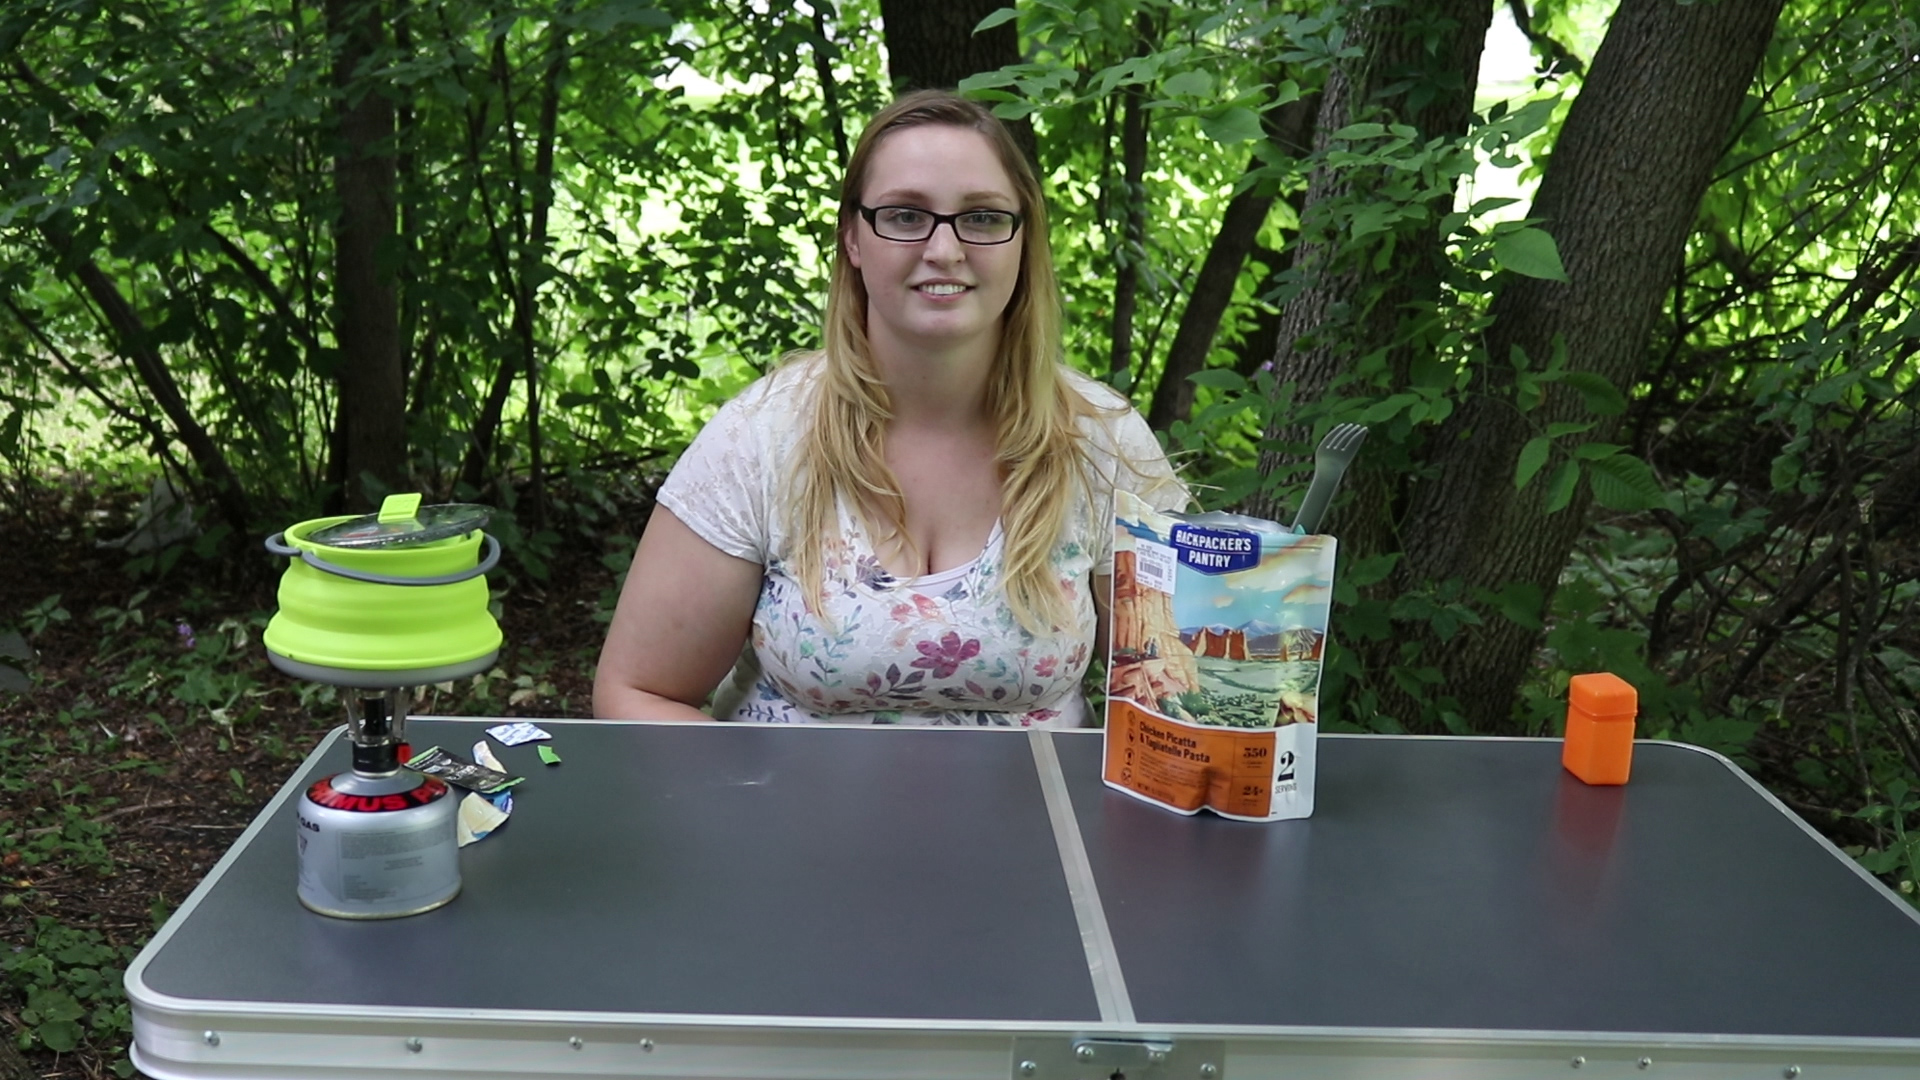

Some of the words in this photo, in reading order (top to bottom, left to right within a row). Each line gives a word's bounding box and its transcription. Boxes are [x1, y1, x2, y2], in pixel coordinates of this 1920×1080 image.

[1175, 529, 1252, 552] BACKPACKER'S
[1188, 549, 1231, 568] PANTRY
[1140, 720, 1165, 740] Chicken
[1183, 748, 1210, 763] Pasta
[1277, 750, 1295, 782] 2
[300, 816, 320, 832] GAS
